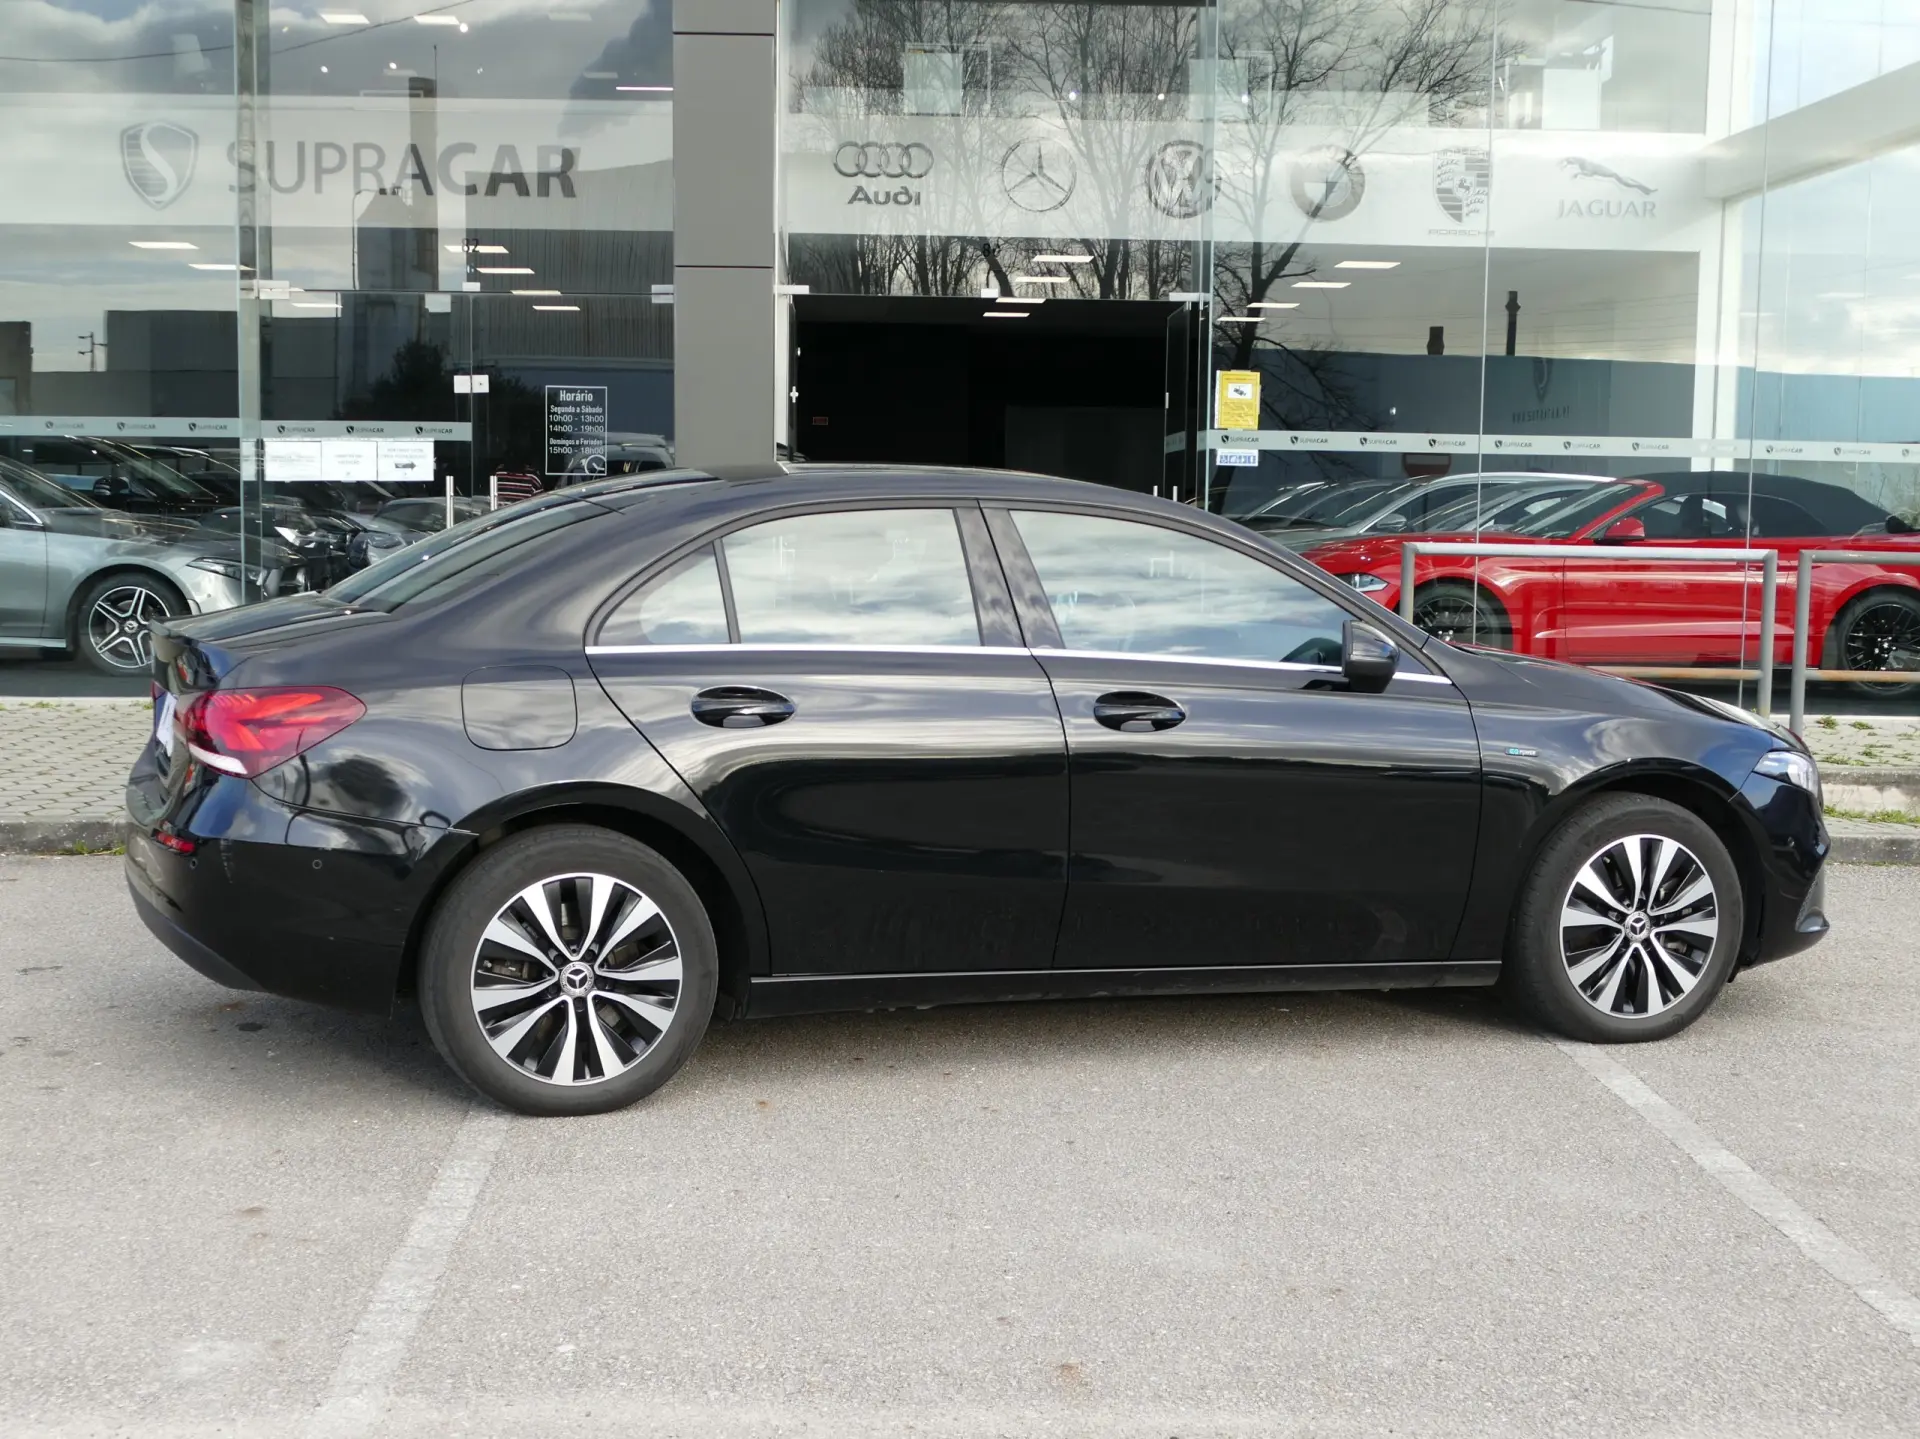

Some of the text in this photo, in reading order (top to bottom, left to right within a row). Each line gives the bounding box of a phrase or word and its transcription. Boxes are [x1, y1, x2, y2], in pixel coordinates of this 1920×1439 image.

[226, 140, 581, 198] SUPRACAR
[847, 185, 920, 205] Audi
[1556, 199, 1657, 219] JAGUAR
[462, 238, 479, 252] 82
[560, 390, 593, 401] Horário
[550, 405, 575, 414] Segunda
[581, 405, 603, 413] Sábado
[549, 414, 573, 422] 10h00
